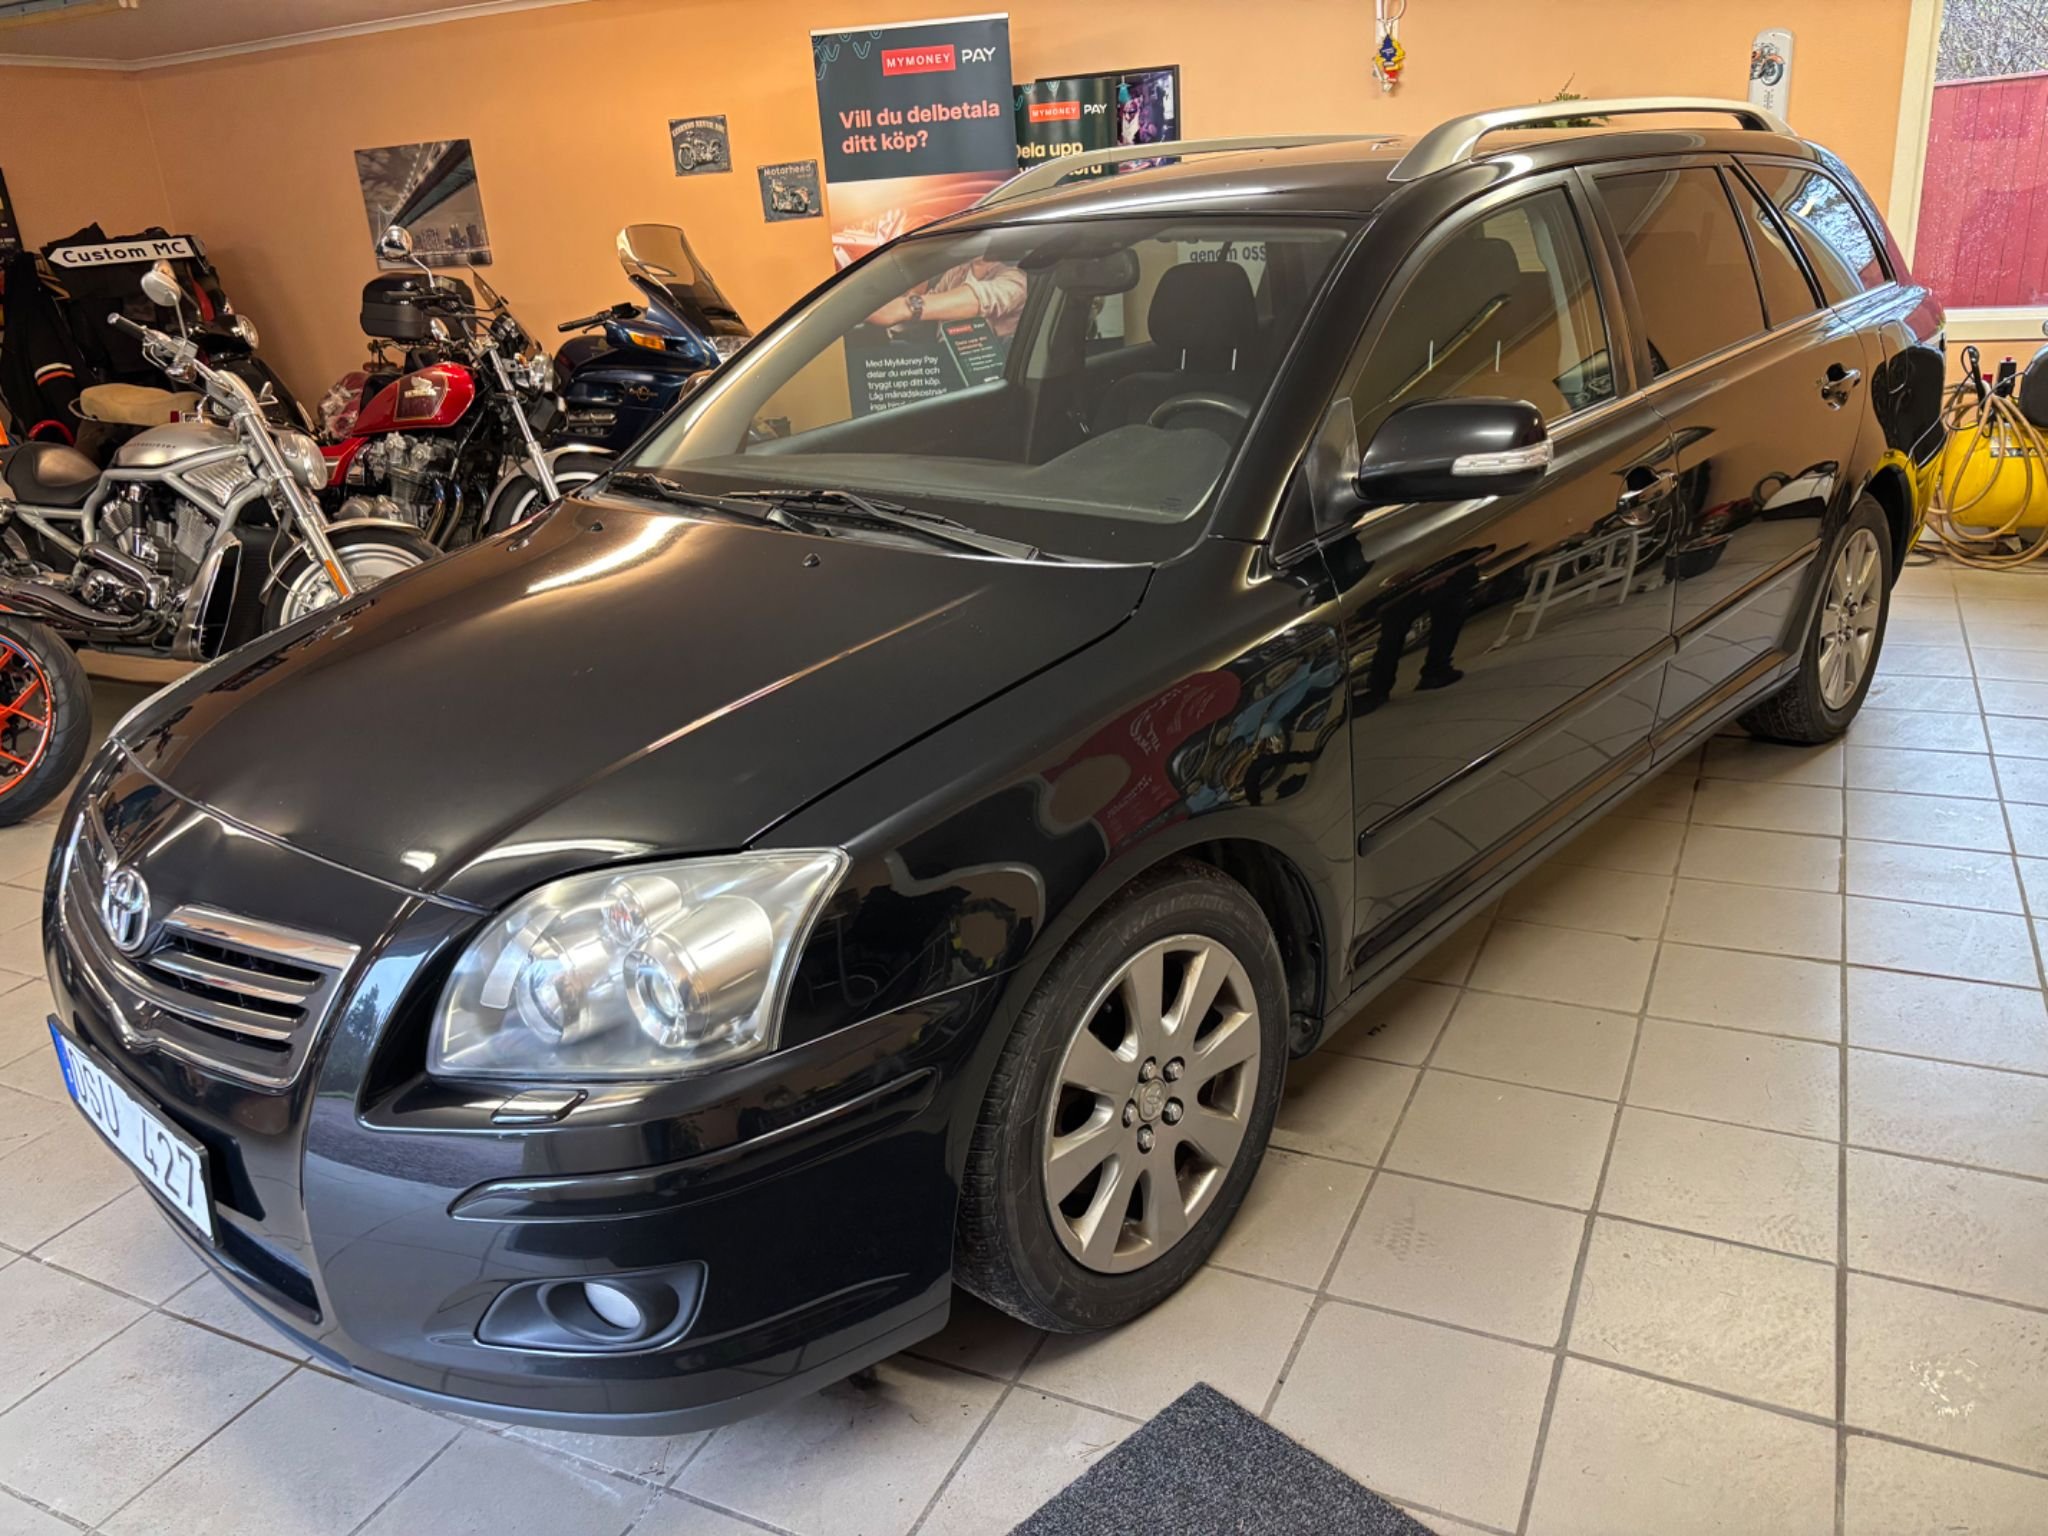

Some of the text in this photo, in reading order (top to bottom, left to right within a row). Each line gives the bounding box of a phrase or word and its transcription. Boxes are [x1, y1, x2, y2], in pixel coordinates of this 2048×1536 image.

[886, 46, 996, 68] MYMONEY PAY
[839, 99, 1000, 129] Vill du delbetala
[1032, 103, 1107, 117] MYMONEY PAY
[842, 129, 928, 154] ditt köp?
[1049, 141, 1084, 158] upp
[62, 241, 186, 263] Custom MC
[866, 359, 883, 368] Med
[924, 355, 938, 365] Pay
[888, 369, 899, 377] du
[925, 366, 940, 375] och
[867, 381, 892, 391] tryggt
[893, 380, 908, 388] upp
[142, 1117, 195, 1209] 427
